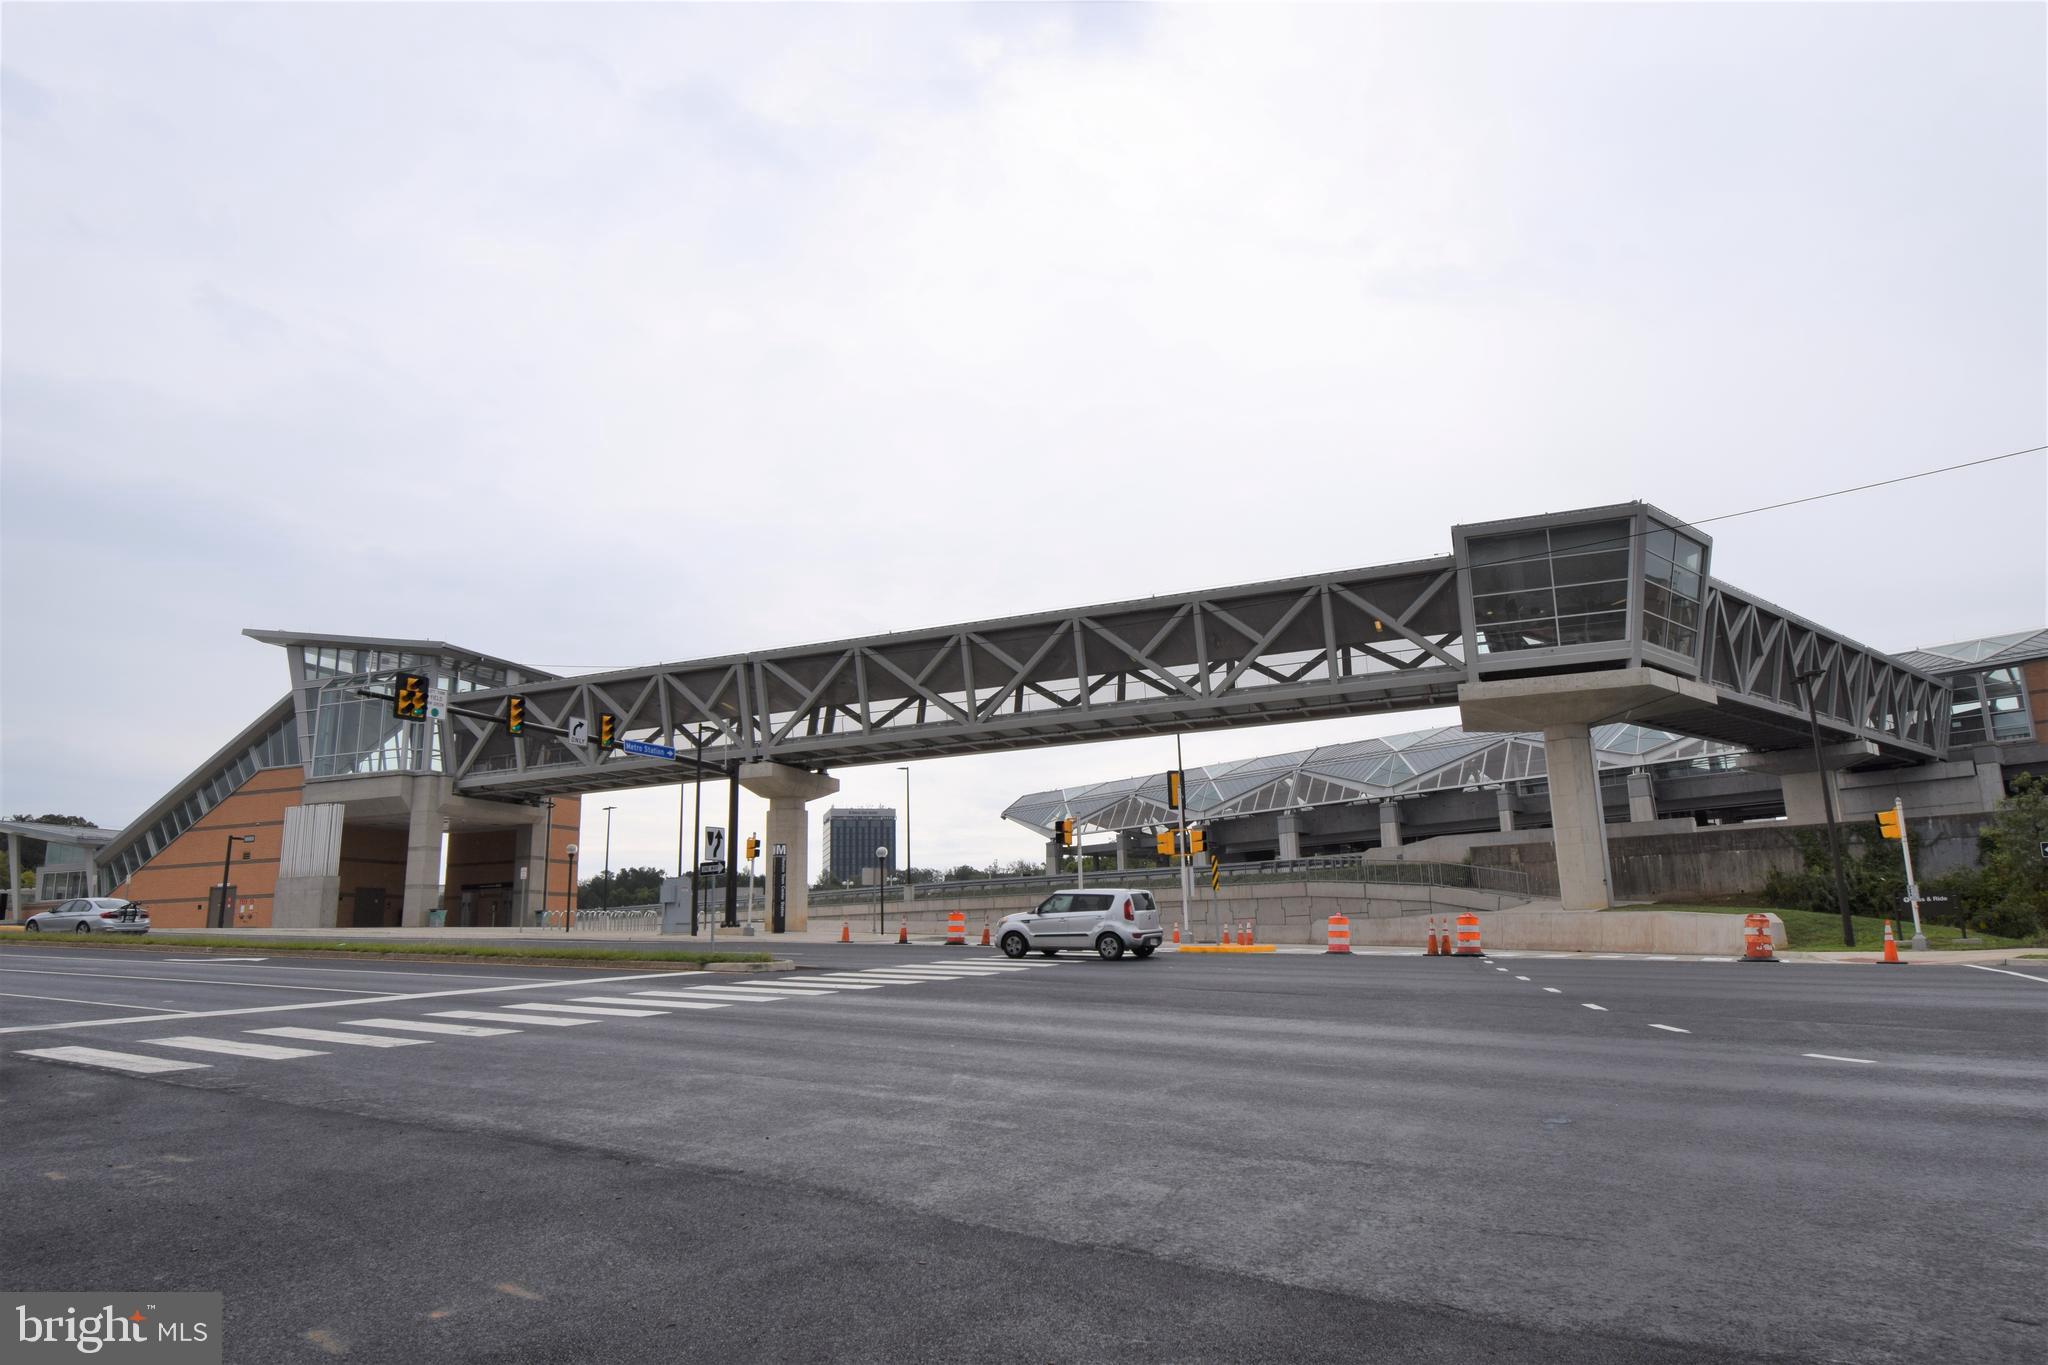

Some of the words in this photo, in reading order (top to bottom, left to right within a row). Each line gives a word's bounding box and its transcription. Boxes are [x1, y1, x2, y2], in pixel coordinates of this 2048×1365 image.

[625, 742, 643, 752] Metro
[643, 745, 665, 756] Station
[776, 844, 786, 855] M
